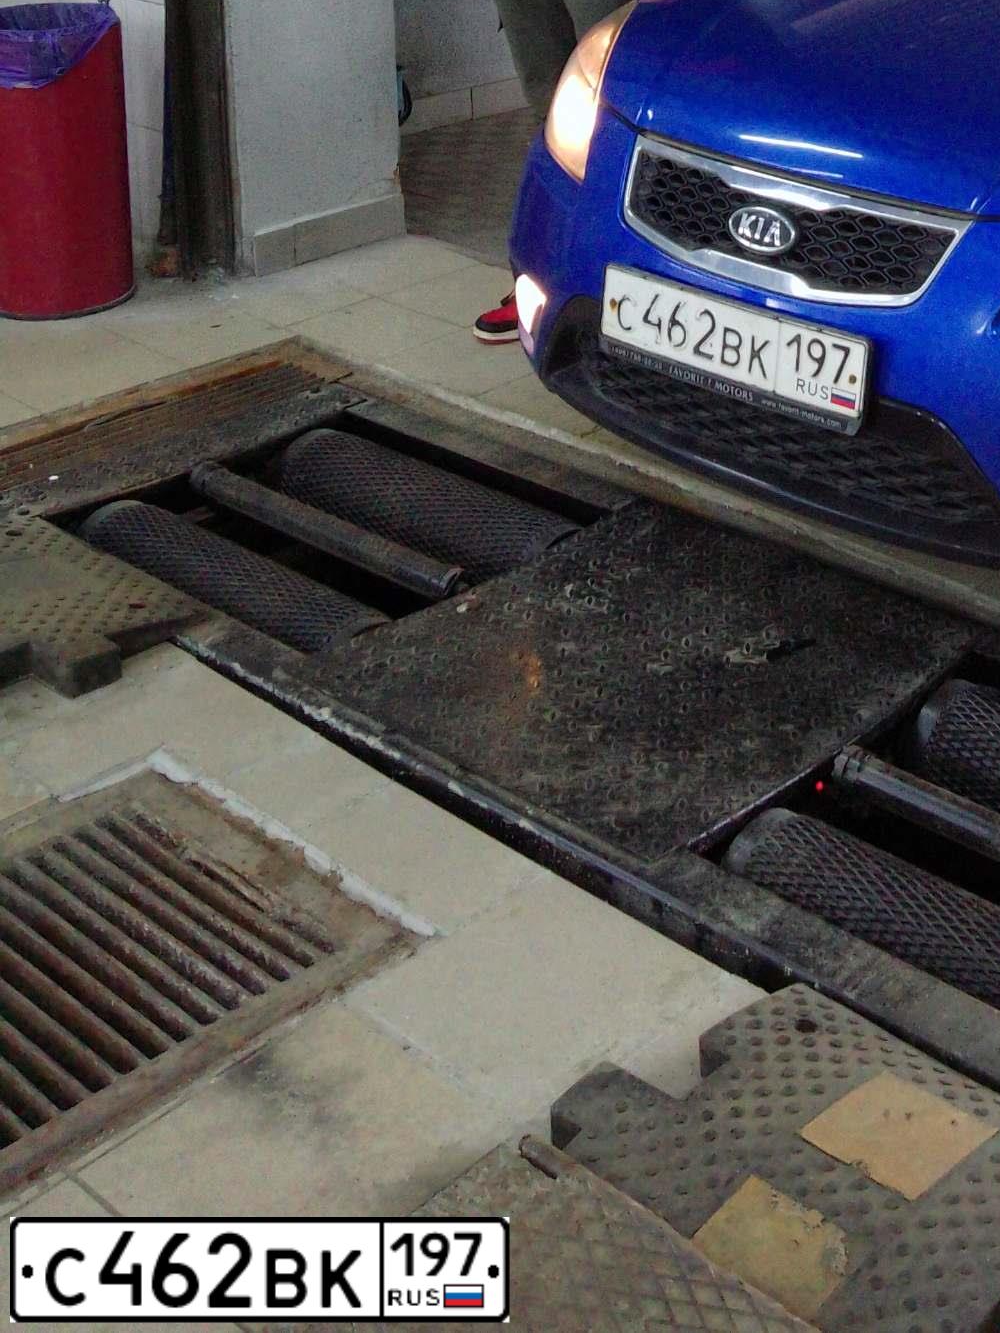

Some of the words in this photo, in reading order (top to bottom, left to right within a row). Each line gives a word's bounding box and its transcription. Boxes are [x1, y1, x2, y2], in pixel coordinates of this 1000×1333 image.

[737, 214, 782, 247] KIA
[616, 293, 770, 379] С462ВК
[786, 332, 851, 385] 197
[715, 380, 753, 402] MOTORS
[795, 377, 829, 401] RUS
